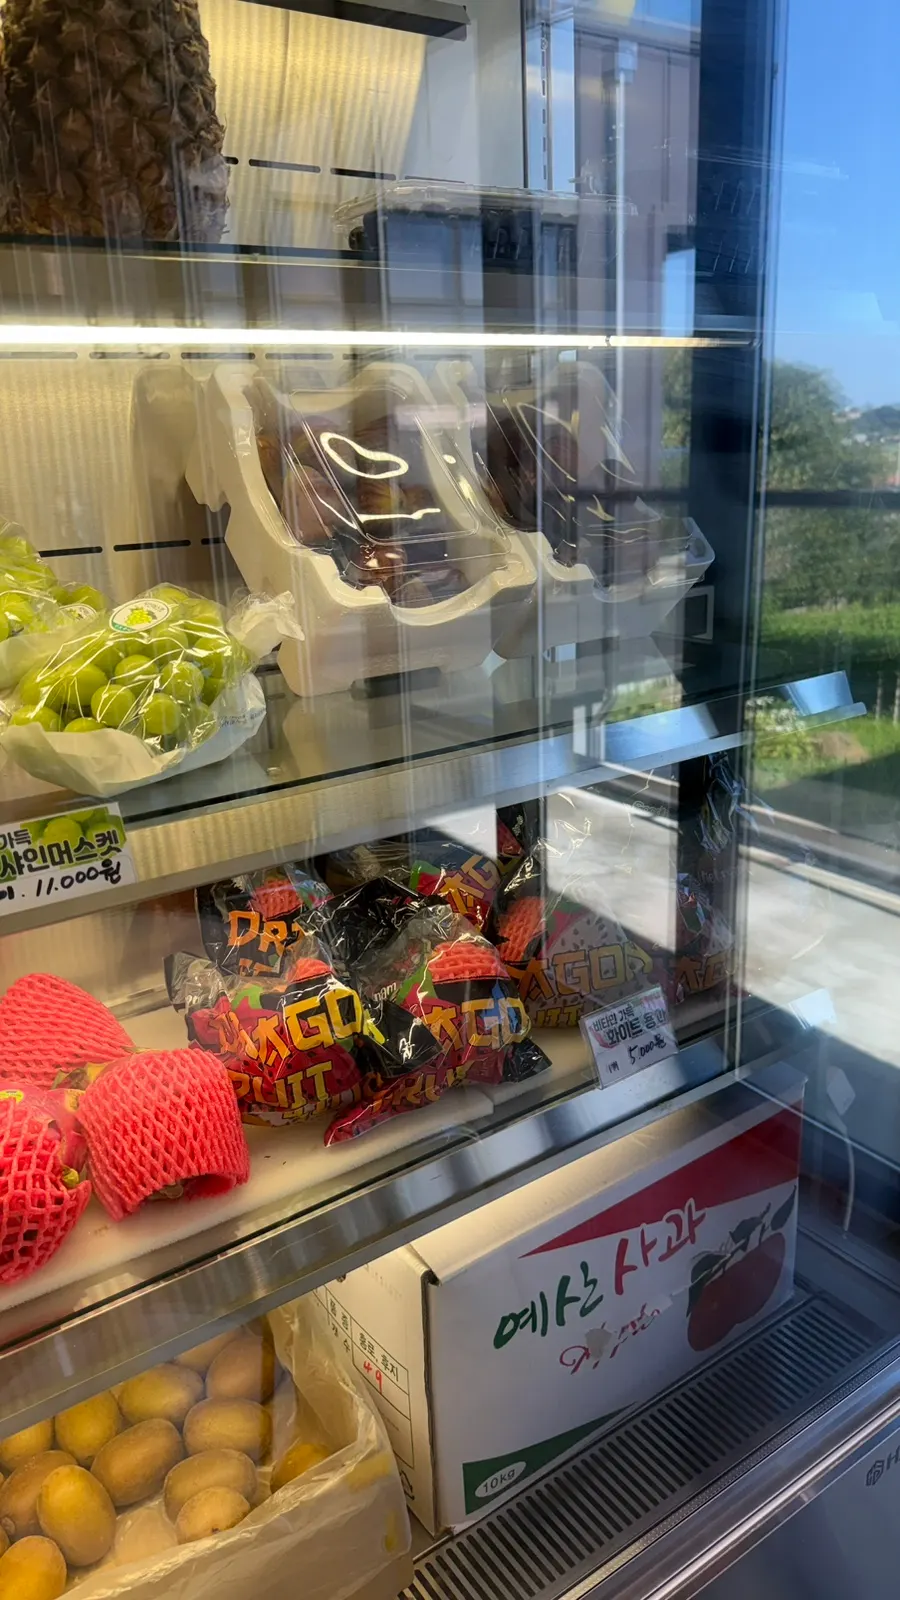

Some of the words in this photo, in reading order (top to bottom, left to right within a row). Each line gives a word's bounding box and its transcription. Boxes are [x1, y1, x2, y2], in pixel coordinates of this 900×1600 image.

[593, 1013, 618, 1032] 비타민
[606, 1018, 643, 1045] 화이트
[493, 1260, 604, 1349] 예산
[614, 1200, 707, 1296] 사과
[482, 1468, 516, 1494] 10kg
